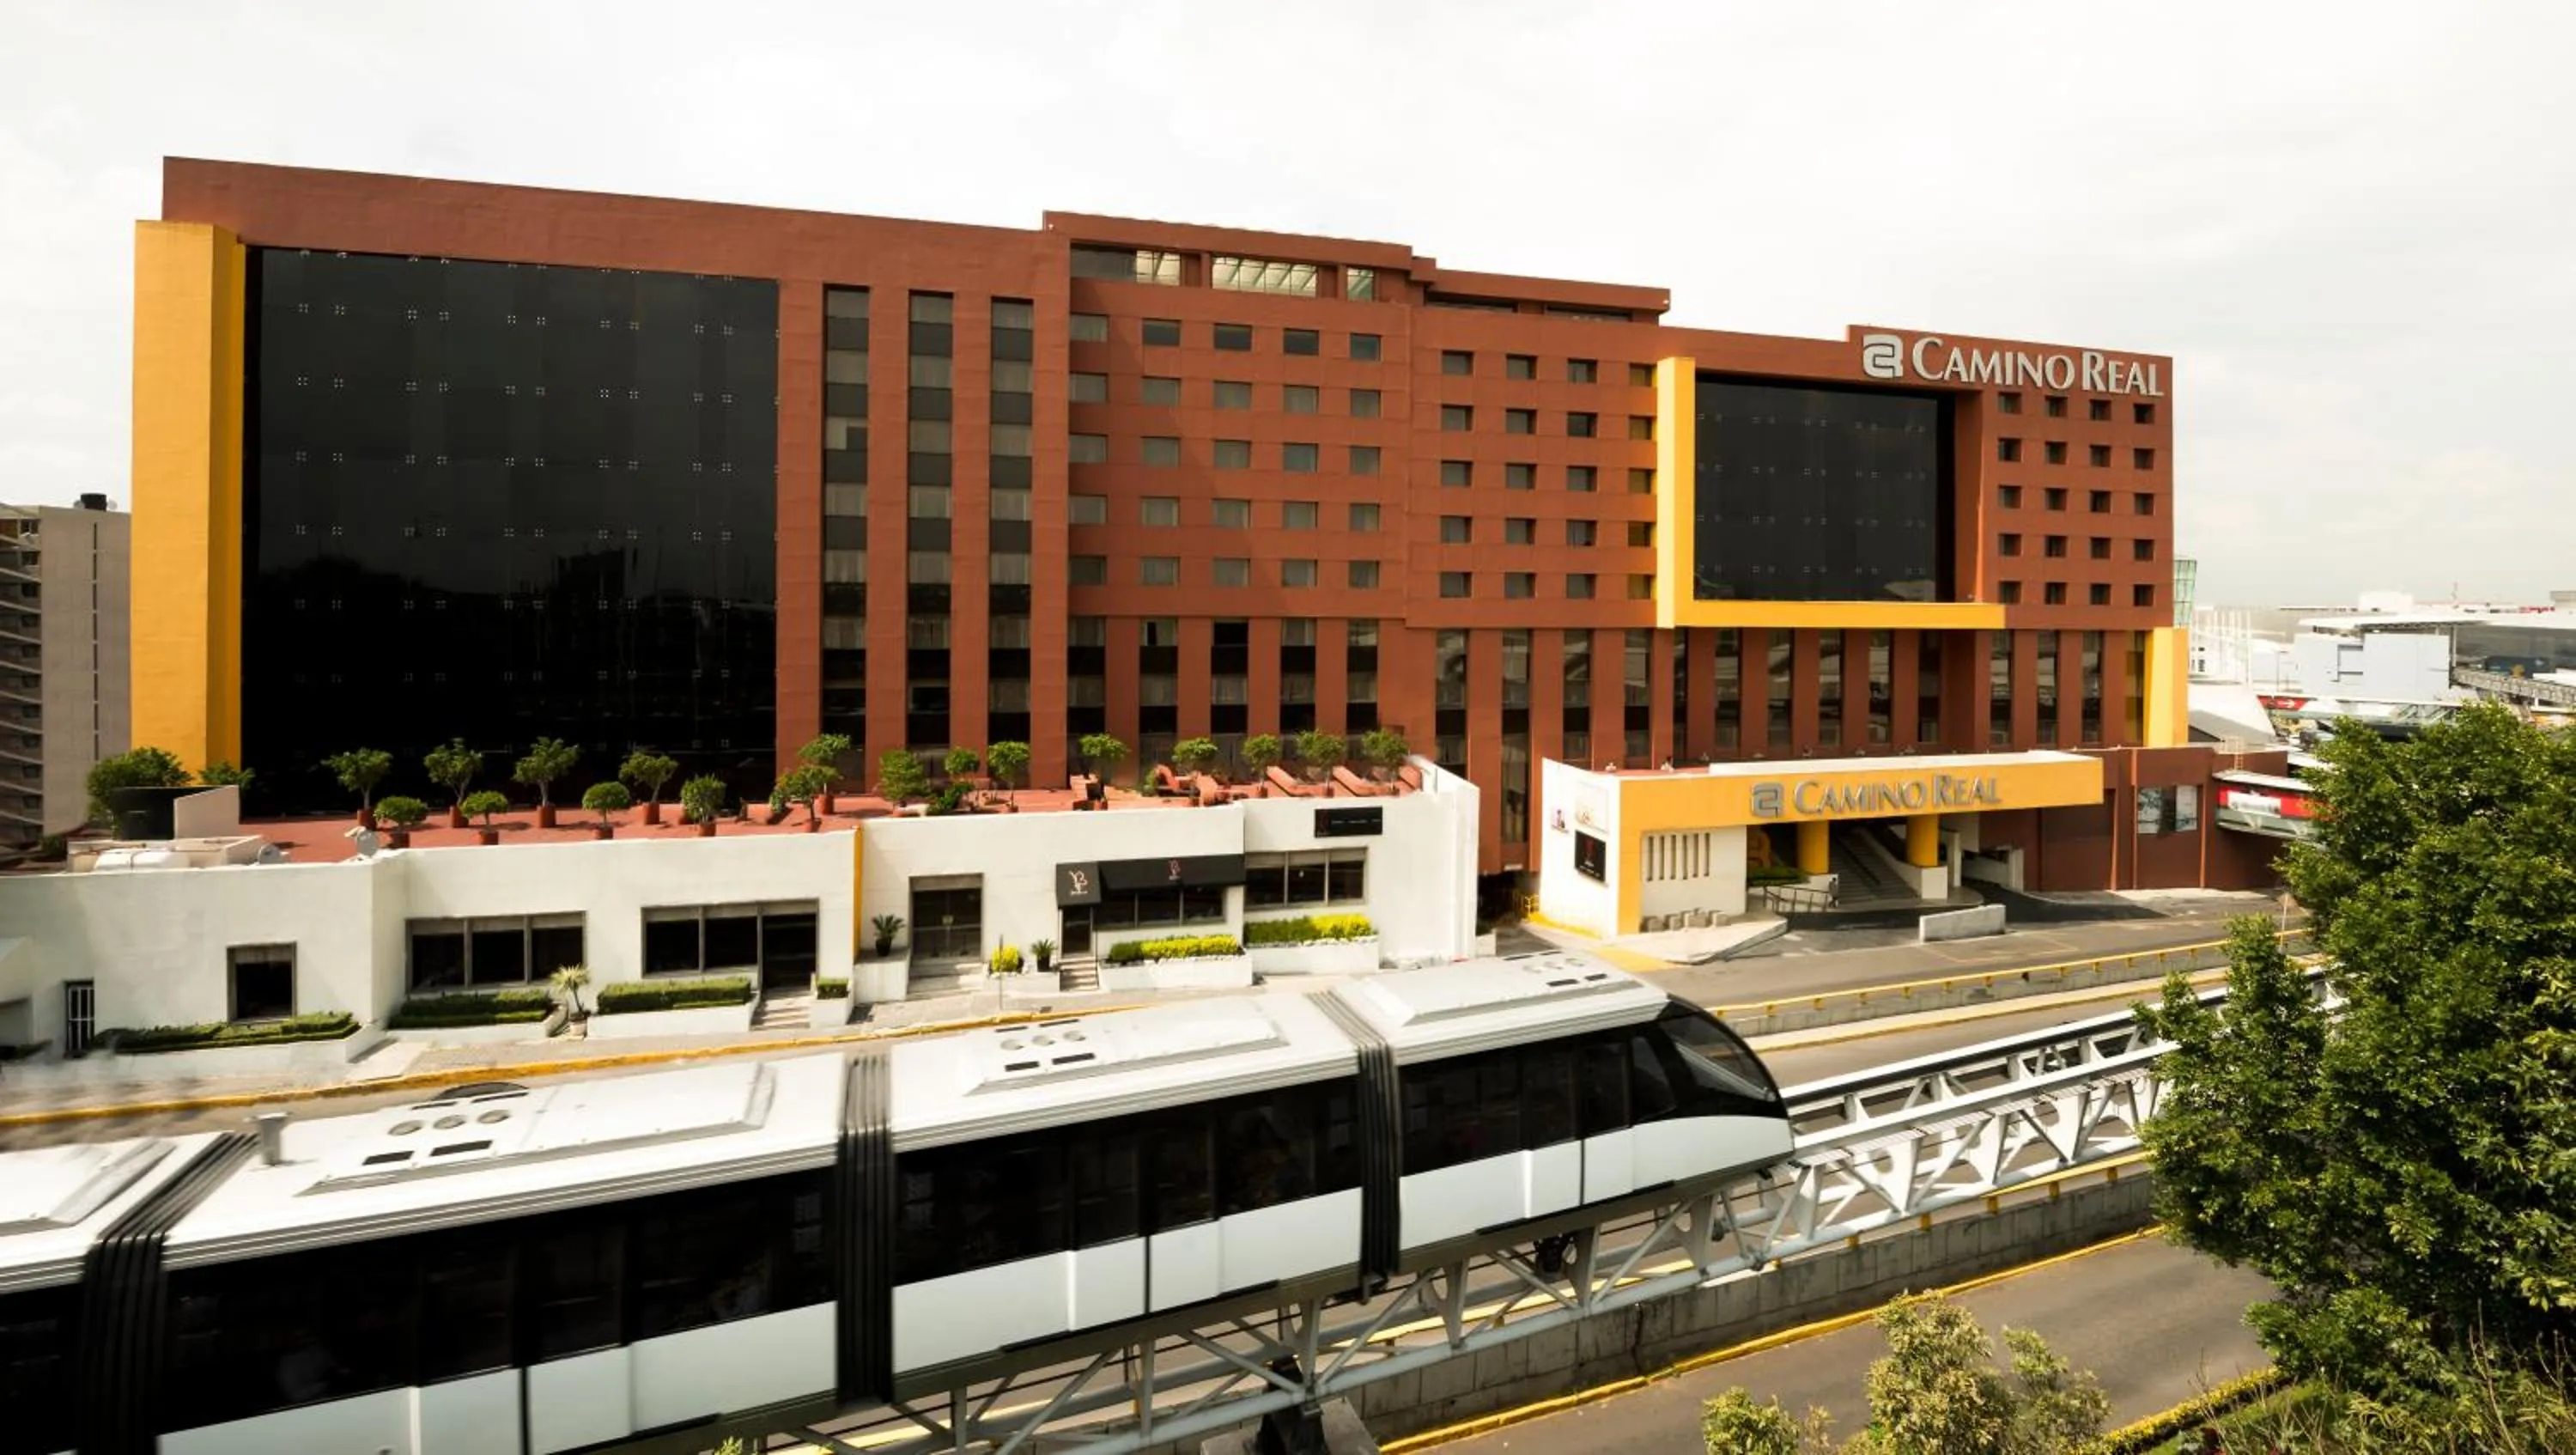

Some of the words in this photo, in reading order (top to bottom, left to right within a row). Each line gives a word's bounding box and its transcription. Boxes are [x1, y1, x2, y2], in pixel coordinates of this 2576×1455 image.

[1911, 337, 2075, 390] CAMINO
[2081, 350, 2165, 397] REAL
[1793, 780, 1928, 815] CAMINO
[1934, 774, 2002, 807] REAL
